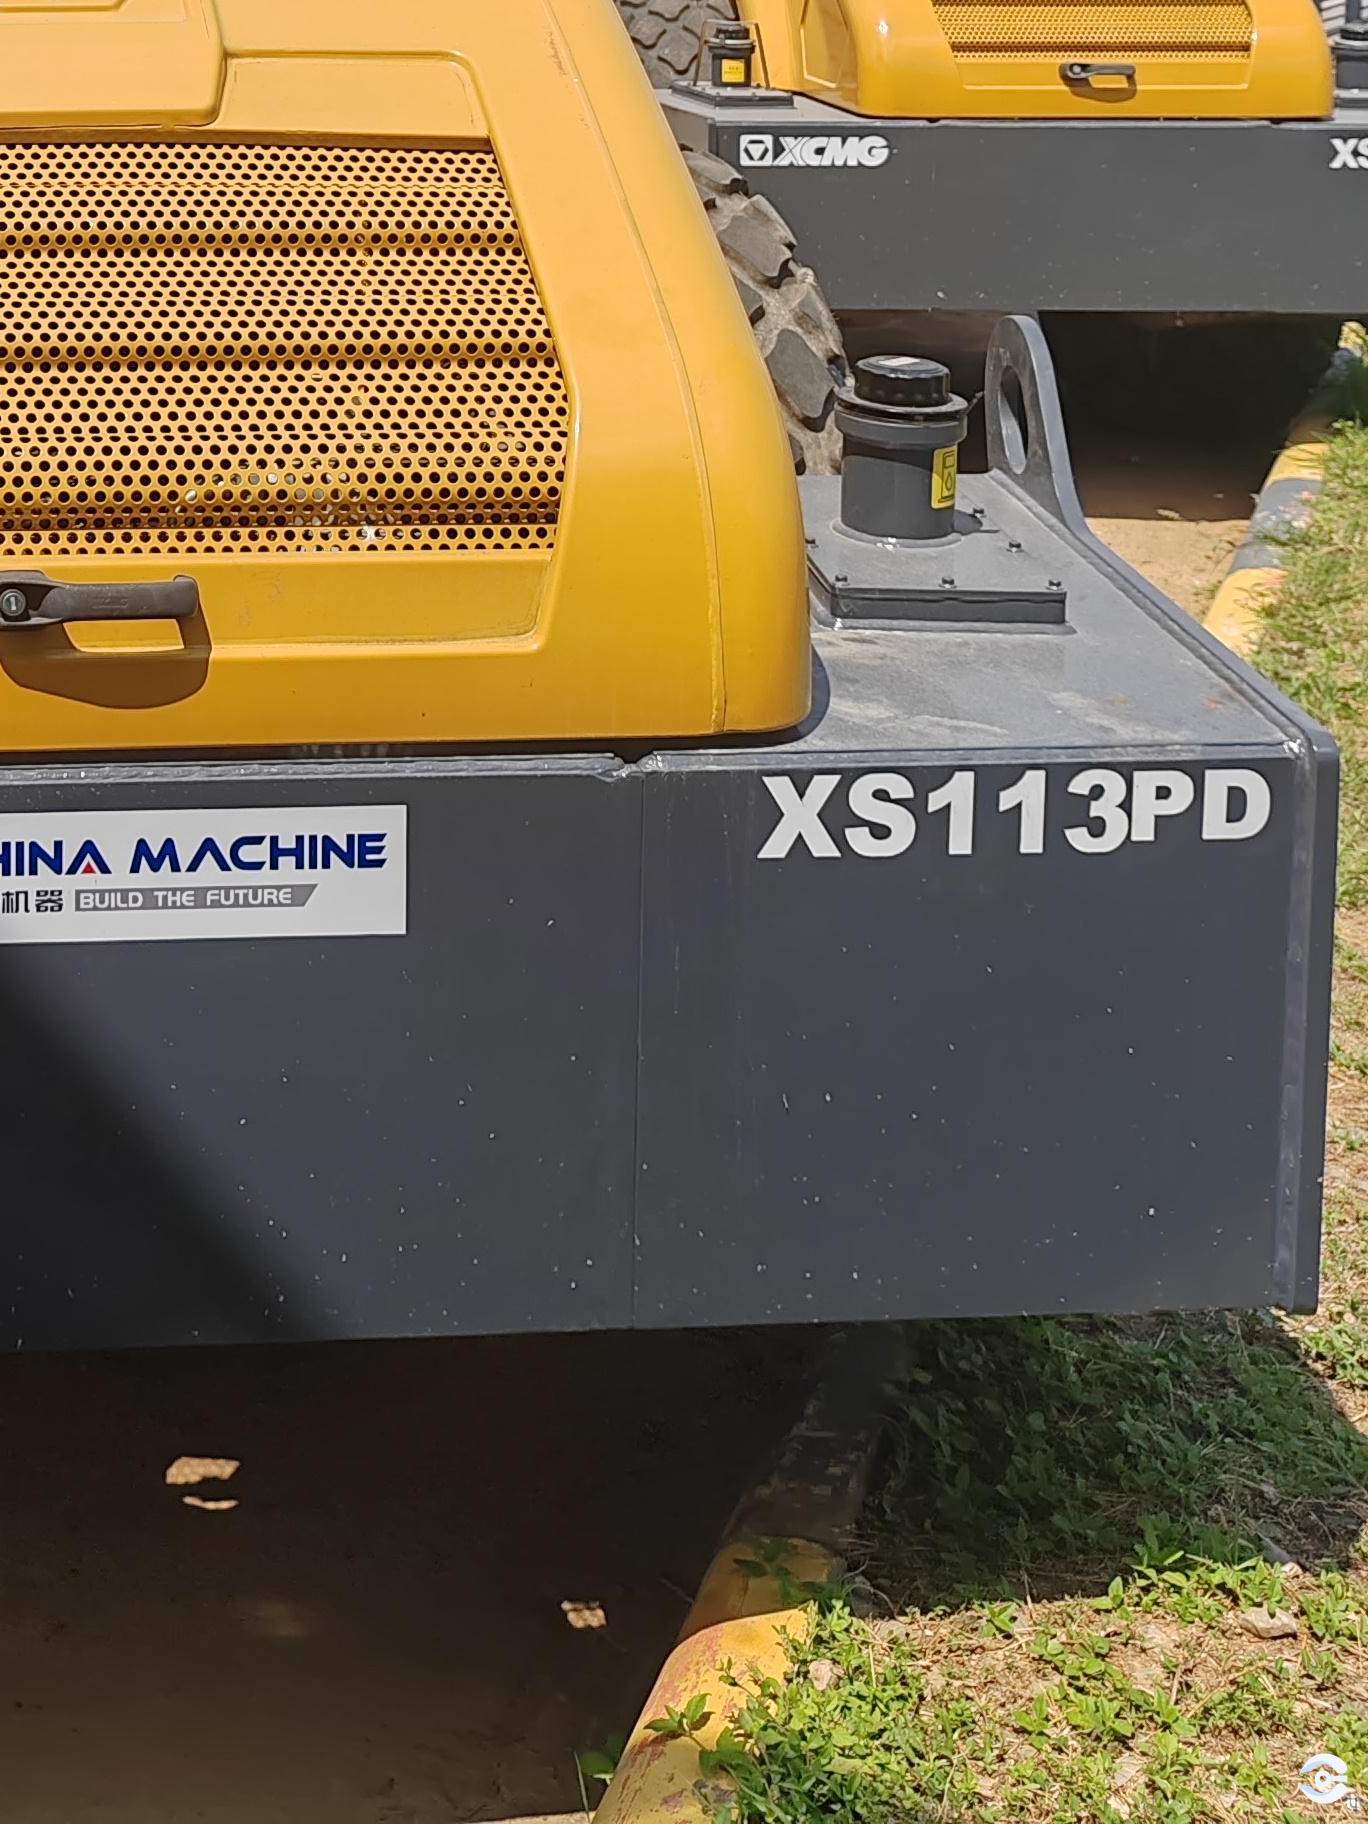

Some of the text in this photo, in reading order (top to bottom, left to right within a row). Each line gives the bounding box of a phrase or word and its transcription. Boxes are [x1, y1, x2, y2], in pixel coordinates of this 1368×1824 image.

[772, 135, 890, 167] XCMG
[756, 768, 1271, 859] XS113PD
[129, 832, 388, 874] MACHINE
[79, 887, 293, 909] BUILD THE FUTURE
